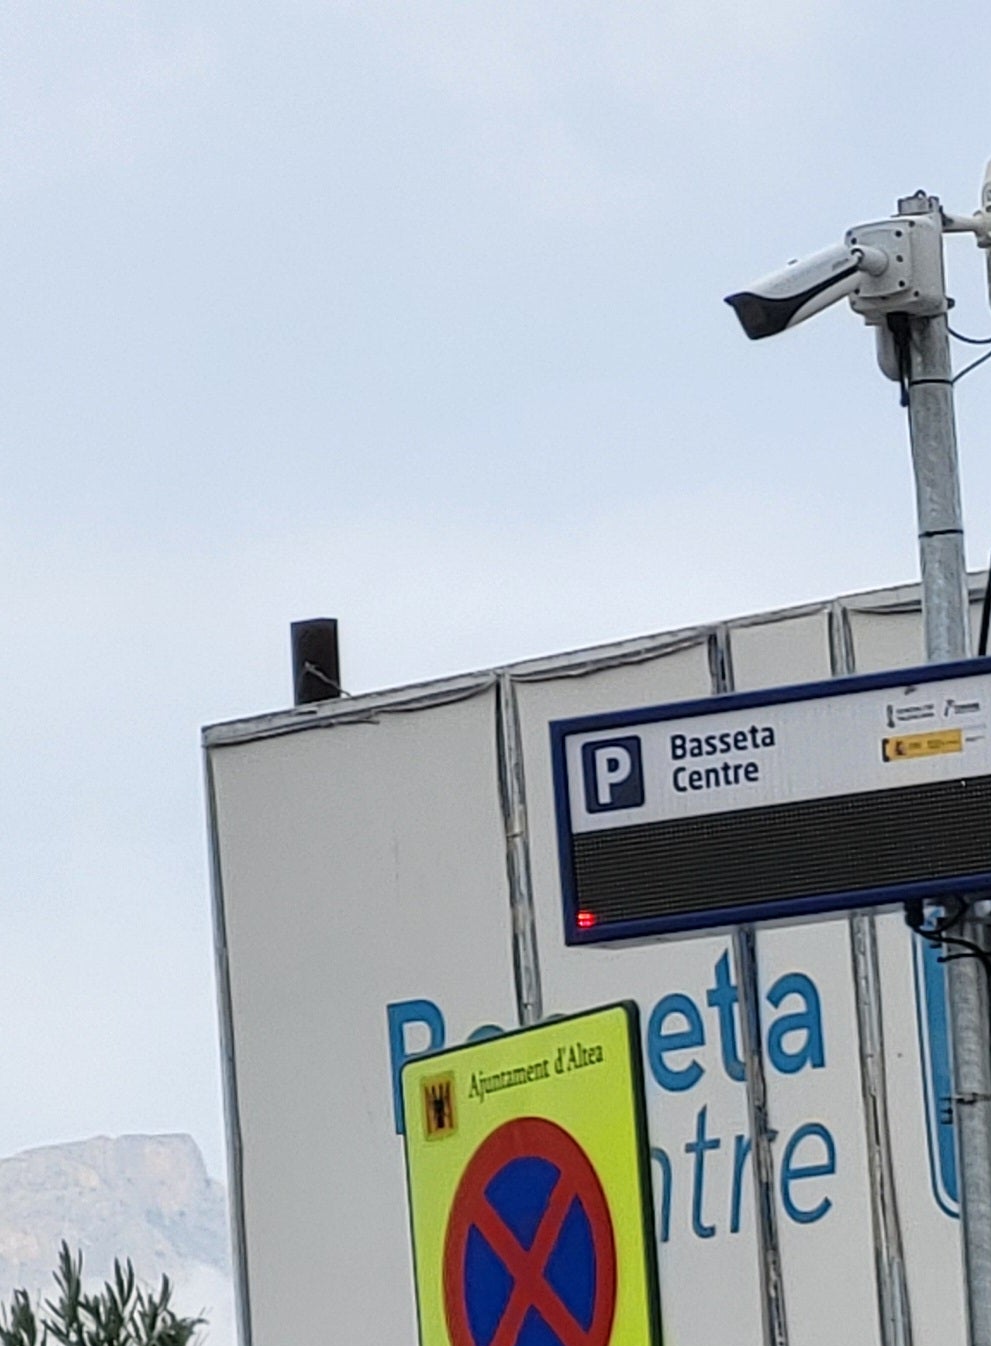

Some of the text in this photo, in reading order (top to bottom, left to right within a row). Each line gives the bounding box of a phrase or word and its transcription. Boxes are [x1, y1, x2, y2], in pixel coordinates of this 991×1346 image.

[670, 725, 775, 760] Basseta
[594, 746, 632, 804] P
[673, 762, 759, 792] Centre
[468, 1042, 604, 1103] Ajuntament d'Altea
